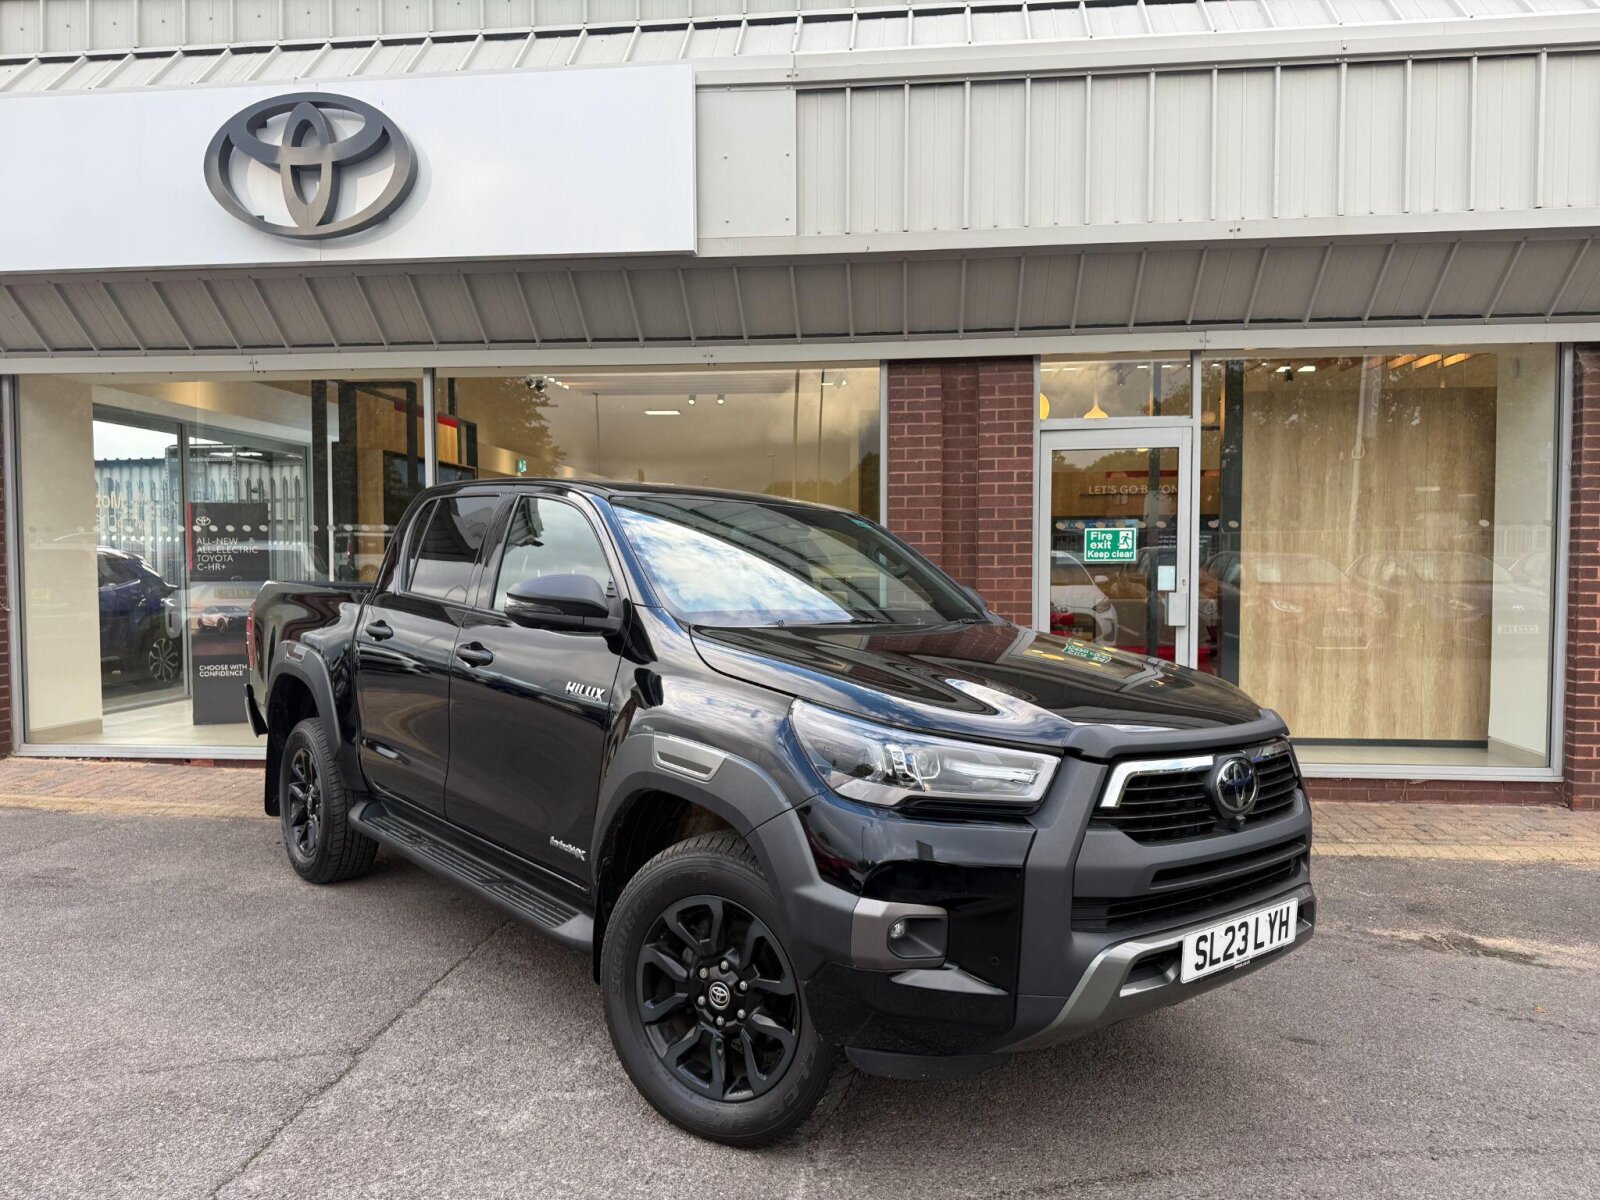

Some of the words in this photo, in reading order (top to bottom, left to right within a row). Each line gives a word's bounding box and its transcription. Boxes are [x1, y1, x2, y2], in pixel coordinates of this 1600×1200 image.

[1120, 485, 1138, 494] GO
[1090, 531, 1113, 541] Fire
[196, 537, 239, 546] ALL-NEW
[1090, 541, 1112, 549] exit
[196, 545, 259, 554] ALL-ELECTRIC
[196, 554, 234, 563] TOYOTA
[1087, 550, 1110, 559] Keep
[1111, 550, 1134, 558] clear
[196, 563, 226, 571] C-HR+
[565, 681, 606, 701] HILUX
[1194, 921, 1249, 971] SL23
[1253, 906, 1290, 950] LYH
